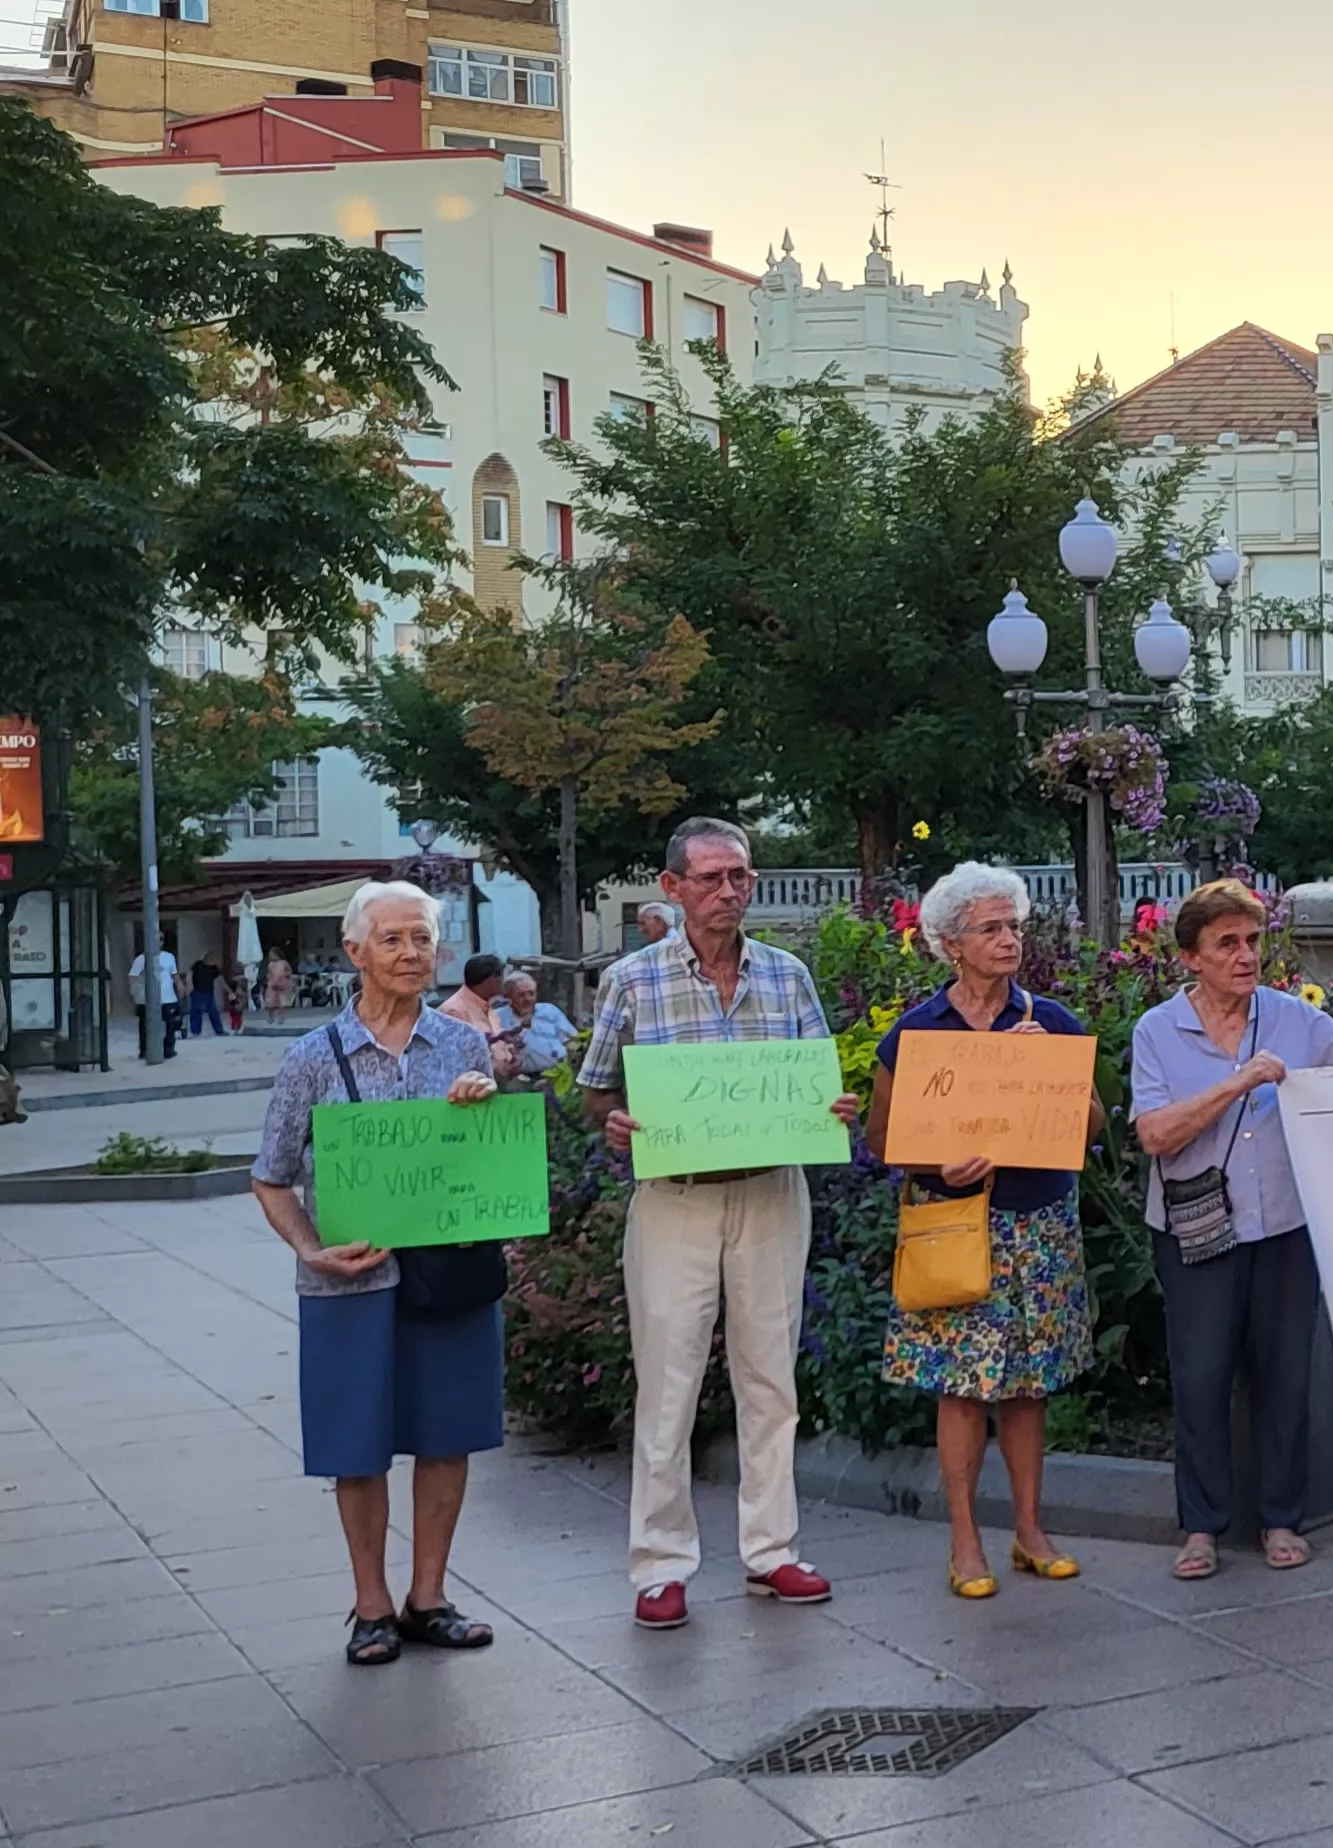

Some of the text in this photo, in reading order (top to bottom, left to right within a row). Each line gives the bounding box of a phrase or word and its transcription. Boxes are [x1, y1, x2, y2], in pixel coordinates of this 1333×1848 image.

[679, 1068, 828, 1107] DIGNAS
[921, 1065, 956, 1099] NO
[339, 1112, 433, 1149] TRABAJO
[472, 1101, 537, 1146] VIVIR
[334, 1155, 373, 1190] NO
[383, 1164, 447, 1196] VIVIR
